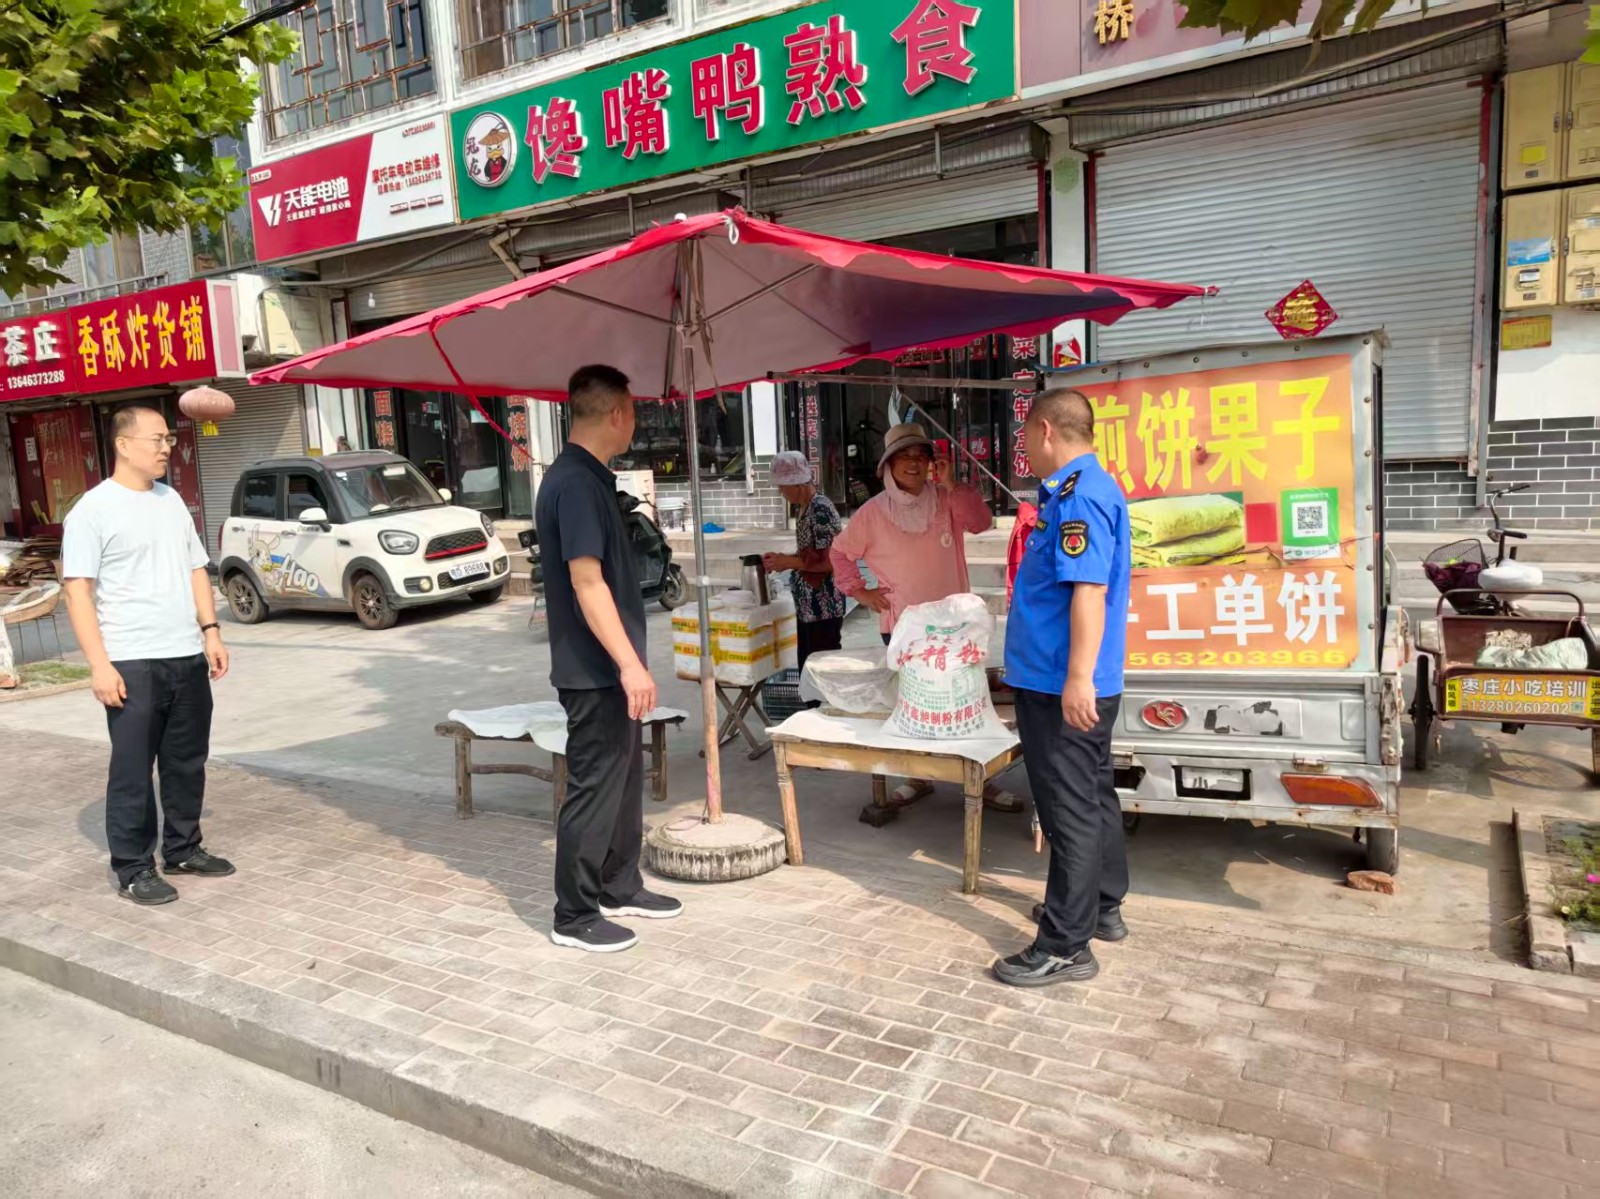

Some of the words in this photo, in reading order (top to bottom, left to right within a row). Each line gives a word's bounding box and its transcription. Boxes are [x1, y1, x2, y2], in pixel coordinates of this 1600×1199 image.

[524, 0, 983, 184] 馋嘴鸭熟食
[284, 176, 350, 212] 天能电池
[1, 320, 61, 367] 茶庄
[77, 295, 206, 378] 香酥炸货铺
[7, 371, 65, 390] 13646373288
[1091, 376, 1342, 495] 煎饼果子
[1127, 570, 1346, 647] 工单饼
[1462, 678, 1586, 698] 枣庄小吃培训
[1471, 700, 1569, 715] 13280260202
